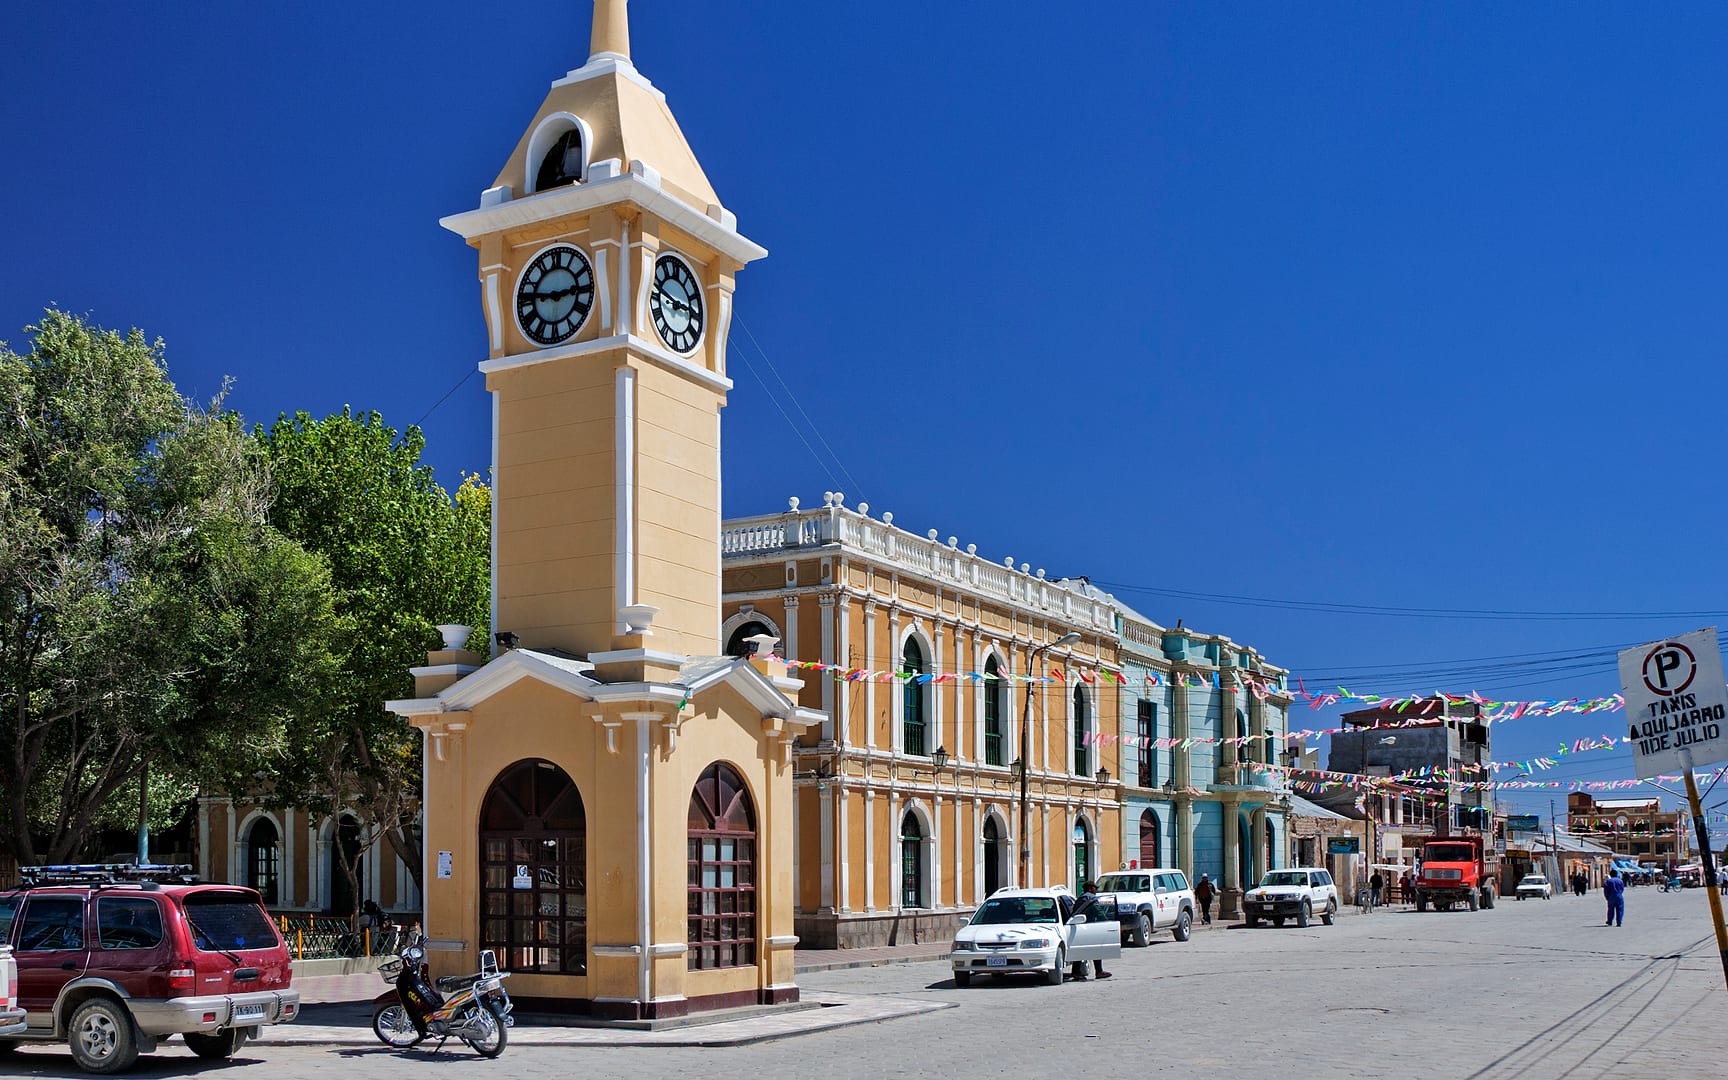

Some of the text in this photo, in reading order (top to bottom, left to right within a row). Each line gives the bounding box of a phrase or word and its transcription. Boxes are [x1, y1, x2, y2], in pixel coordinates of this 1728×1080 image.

[1655, 650, 1680, 688] P
[1648, 693, 1697, 717] TAXIS
[1673, 724, 1720, 748] JULIO
